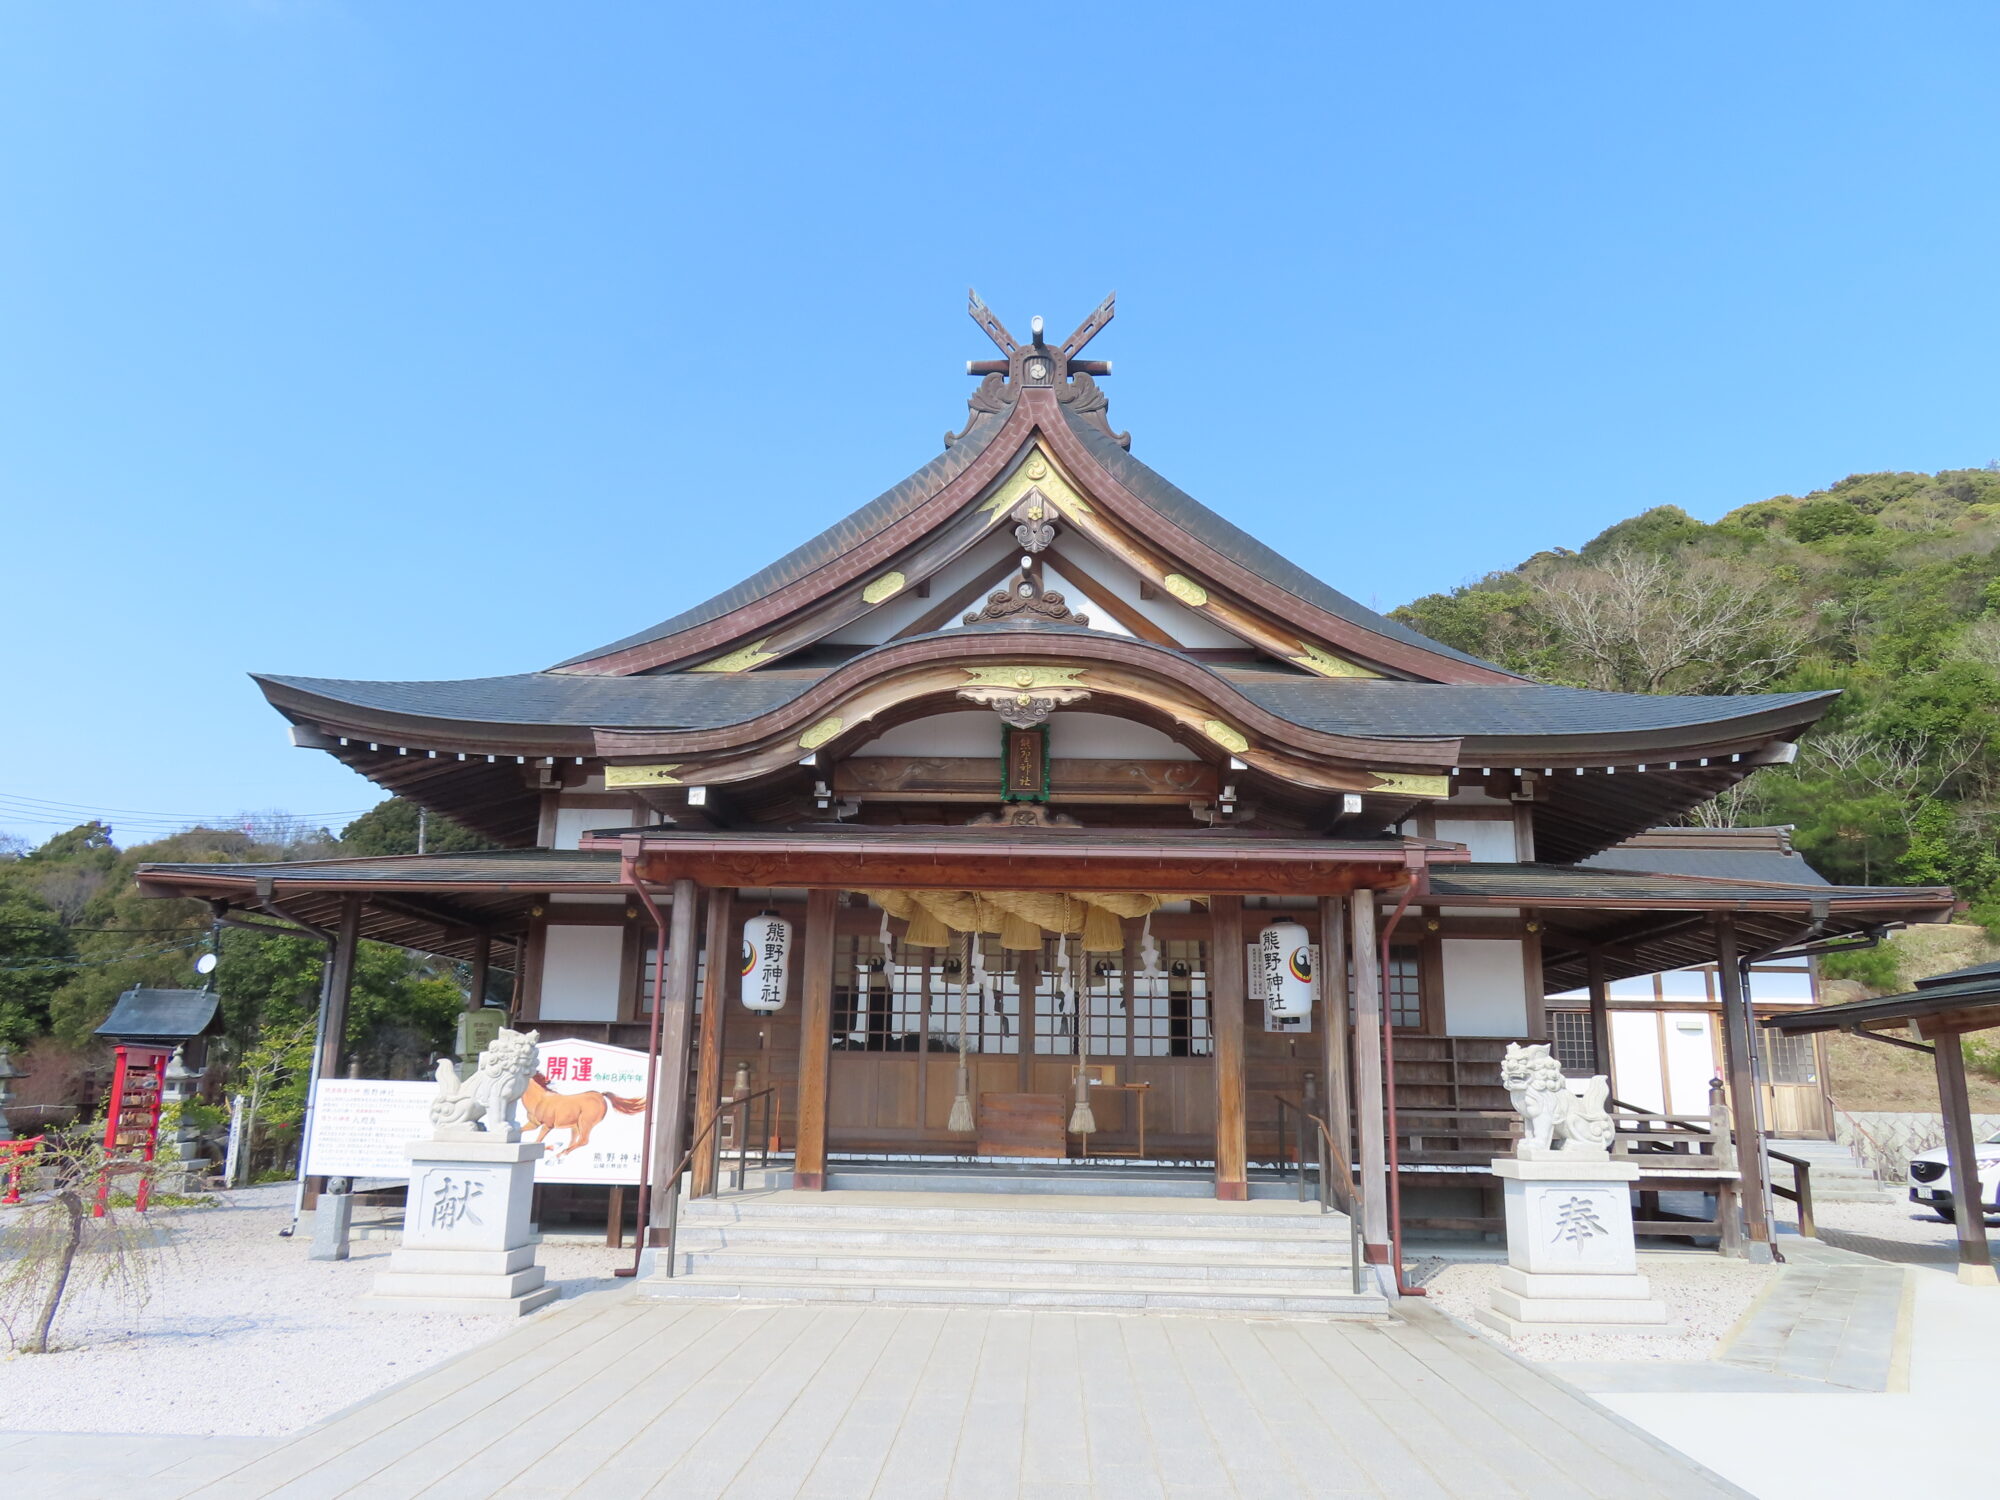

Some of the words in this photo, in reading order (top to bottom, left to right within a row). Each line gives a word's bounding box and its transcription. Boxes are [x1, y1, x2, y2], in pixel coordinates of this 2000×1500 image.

[1019, 737, 1032, 786] 熊野神社
[760, 922, 785, 1003] 熊野神社
[1262, 931, 1287, 1011] 熊野神社
[545, 1056, 593, 1082] 開運
[593, 1152, 641, 1163] 熊野神社
[431, 1176, 485, 1230] 献
[1550, 1195, 1609, 1257] 奉
